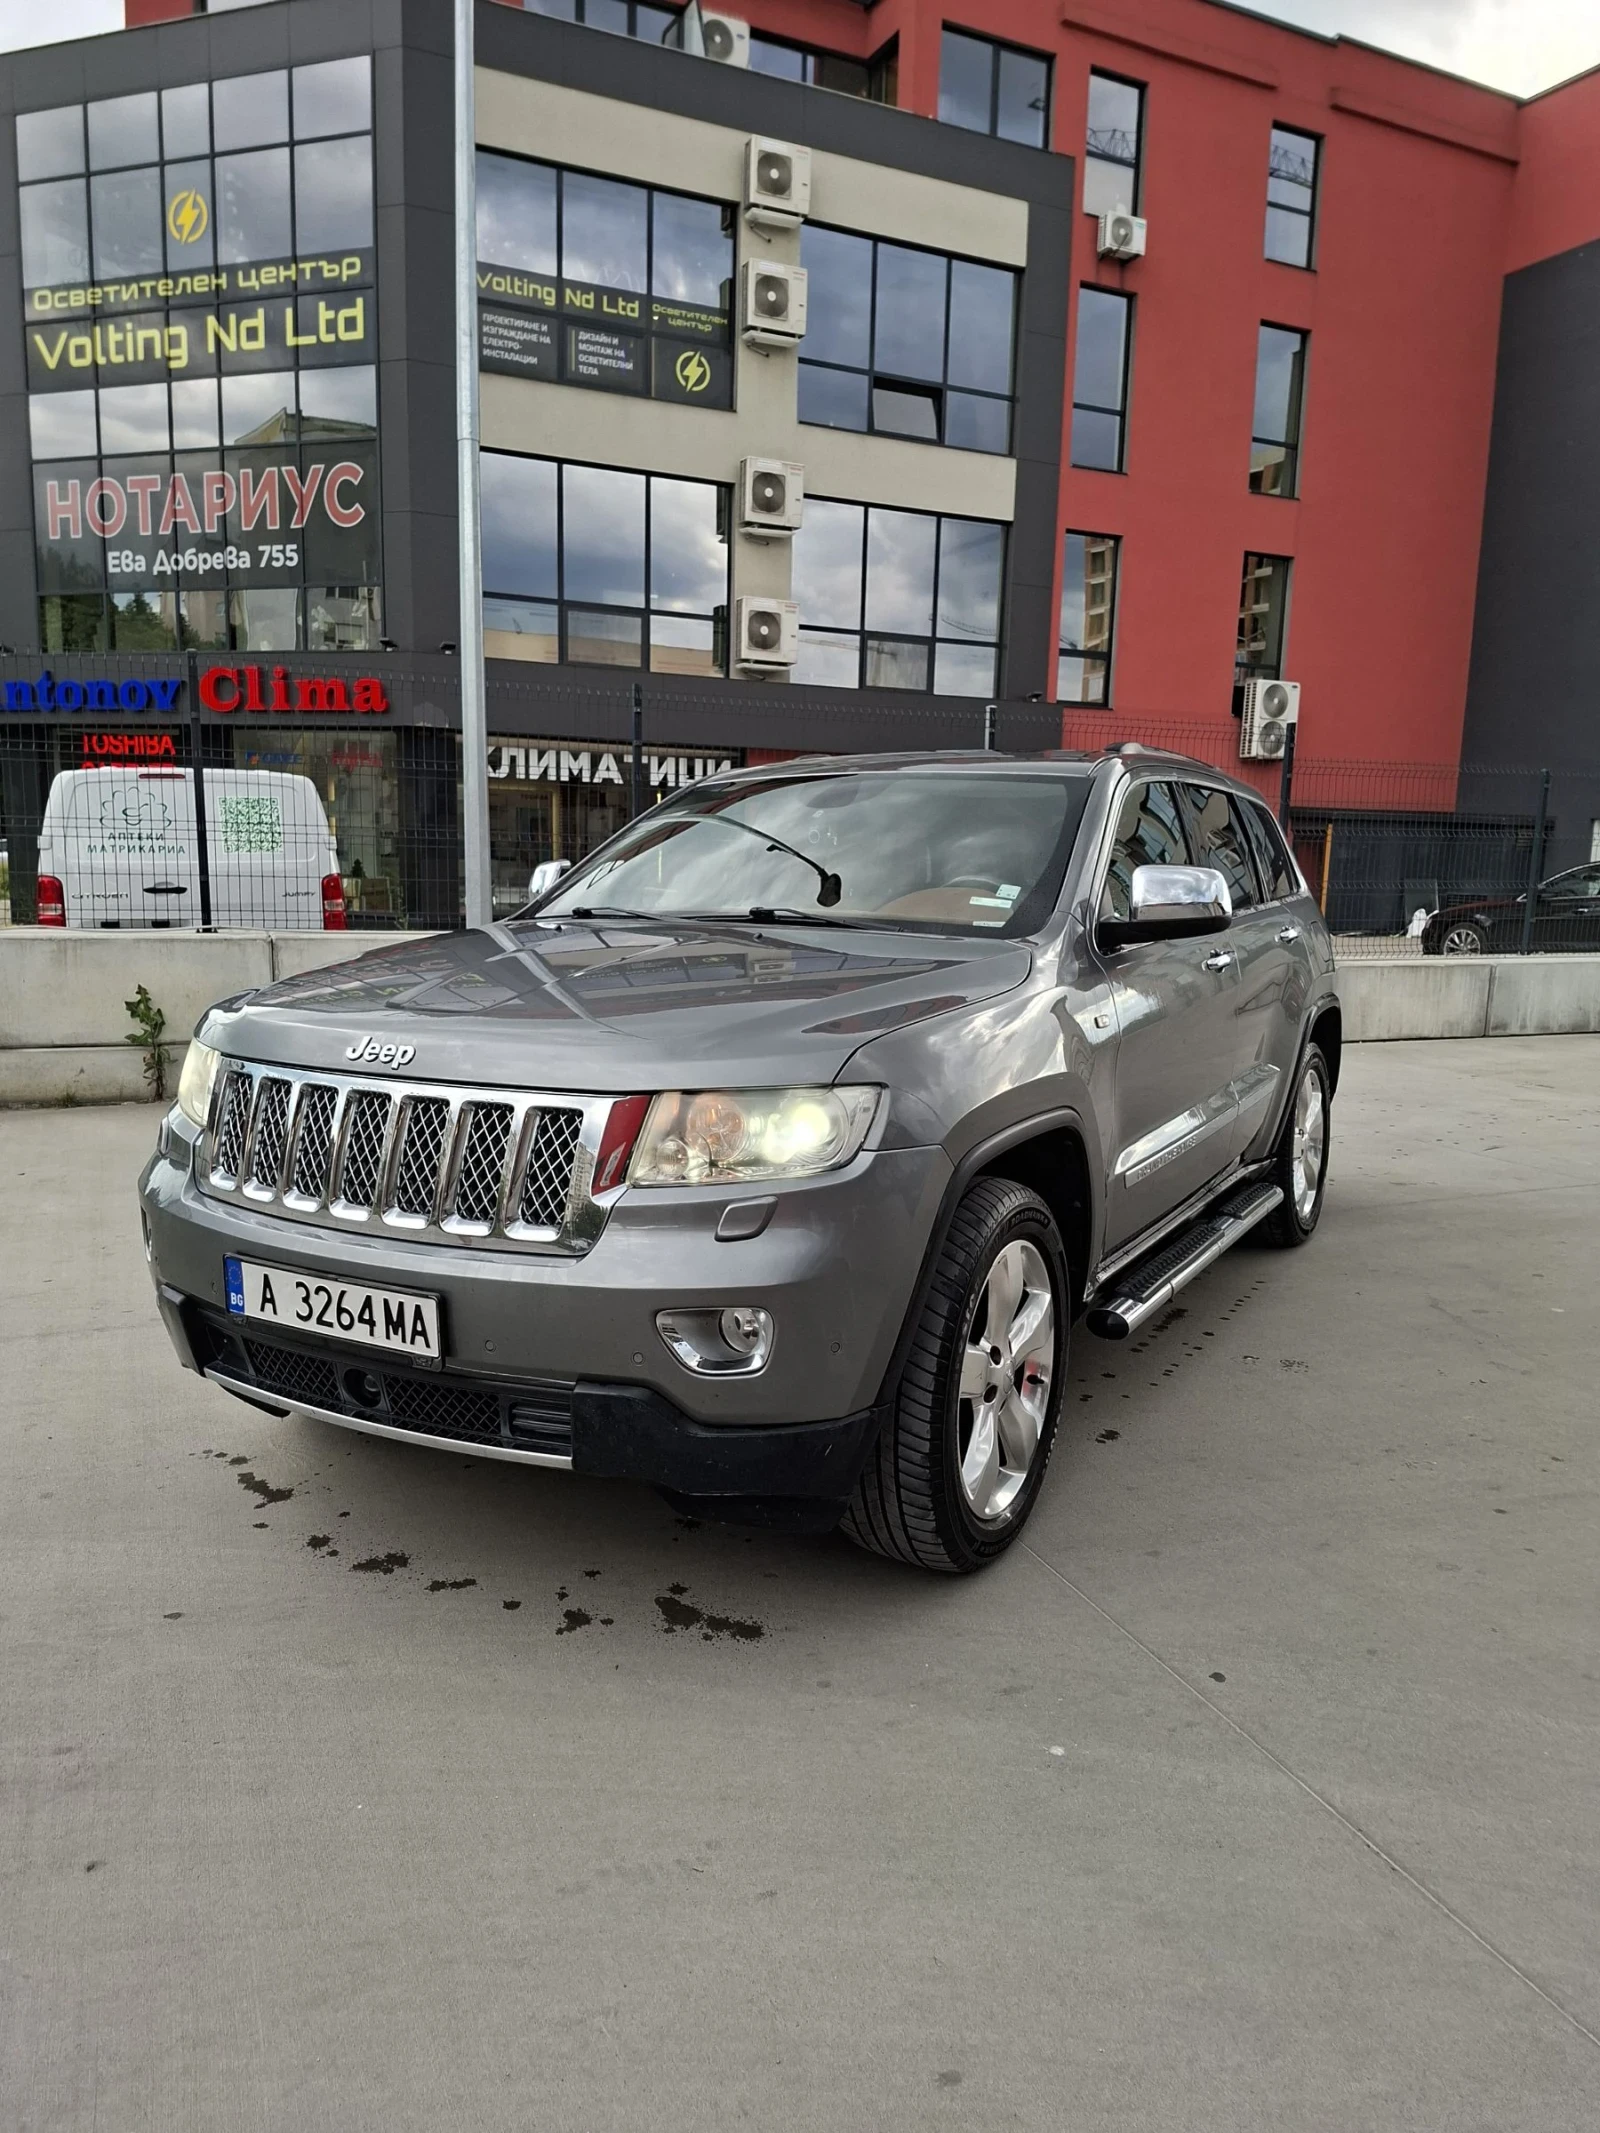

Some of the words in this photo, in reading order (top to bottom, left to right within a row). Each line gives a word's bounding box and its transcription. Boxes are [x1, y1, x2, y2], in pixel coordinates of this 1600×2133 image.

[33, 272, 228, 311] Осветителен
[237, 256, 361, 291] център
[476, 272, 556, 306] Volting
[565, 289, 595, 310] Nd
[603, 295, 639, 318] Ltd
[482, 313, 540, 331] ПРОЕКТИРАНЕ
[541, 323, 548, 332] И
[652, 303, 728, 325] Осветителен
[34, 322, 189, 370] Volting
[207, 308, 265, 353] Nd
[286, 297, 365, 347] Ltd
[482, 325, 538, 342] ИЗГРАЖДАНЕ
[539, 335, 551, 344] НА
[667, 317, 713, 333] център
[482, 336, 522, 350] ЕЛЕКТРО-
[578, 331, 611, 343] ДИЗАЙН
[612, 337, 619, 345] И
[482, 348, 538, 365] ИНСТАЛАЦИИ
[578, 343, 613, 356] МОНТАЖ
[614, 348, 625, 358] НА
[578, 353, 633, 371] ОСВЕТИТЕЛНИ
[578, 364, 599, 376] ТЕЛА
[46, 461, 366, 539] НОТАРИУС
[107, 549, 147, 573] Ева
[153, 546, 251, 575] Добрева
[258, 544, 299, 568] 755
[0, 670, 181, 712] ntonov
[199, 664, 389, 713] Clima
[83, 734, 176, 756] TOSHIBA
[108, 832, 164, 841] АПТЕКИ
[87, 845, 186, 854] МАТРИКАРИА
[346, 1036, 416, 1070] Jeep
[231, 1292, 243, 1306] BG
[259, 1273, 278, 1316] A
